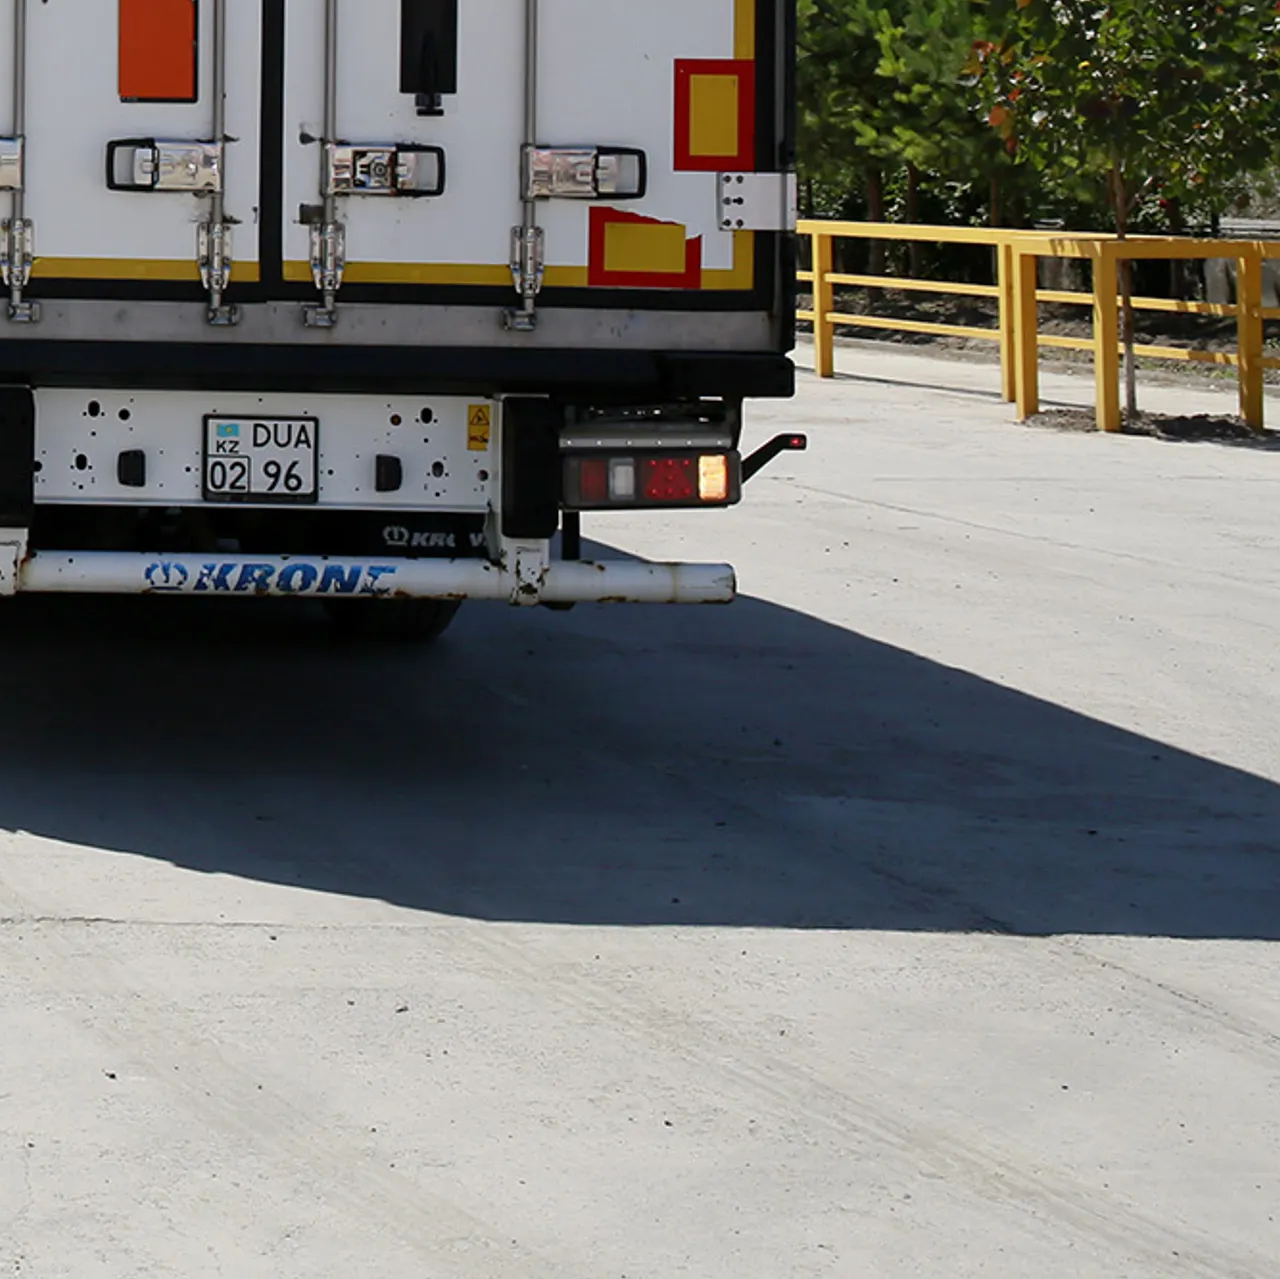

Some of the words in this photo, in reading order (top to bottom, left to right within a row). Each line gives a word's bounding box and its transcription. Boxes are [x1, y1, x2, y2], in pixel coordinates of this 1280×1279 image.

[216, 440, 239, 453] KZ
[253, 423, 311, 449] DUA
[210, 461, 246, 490] 02
[263, 460, 302, 491] 96
